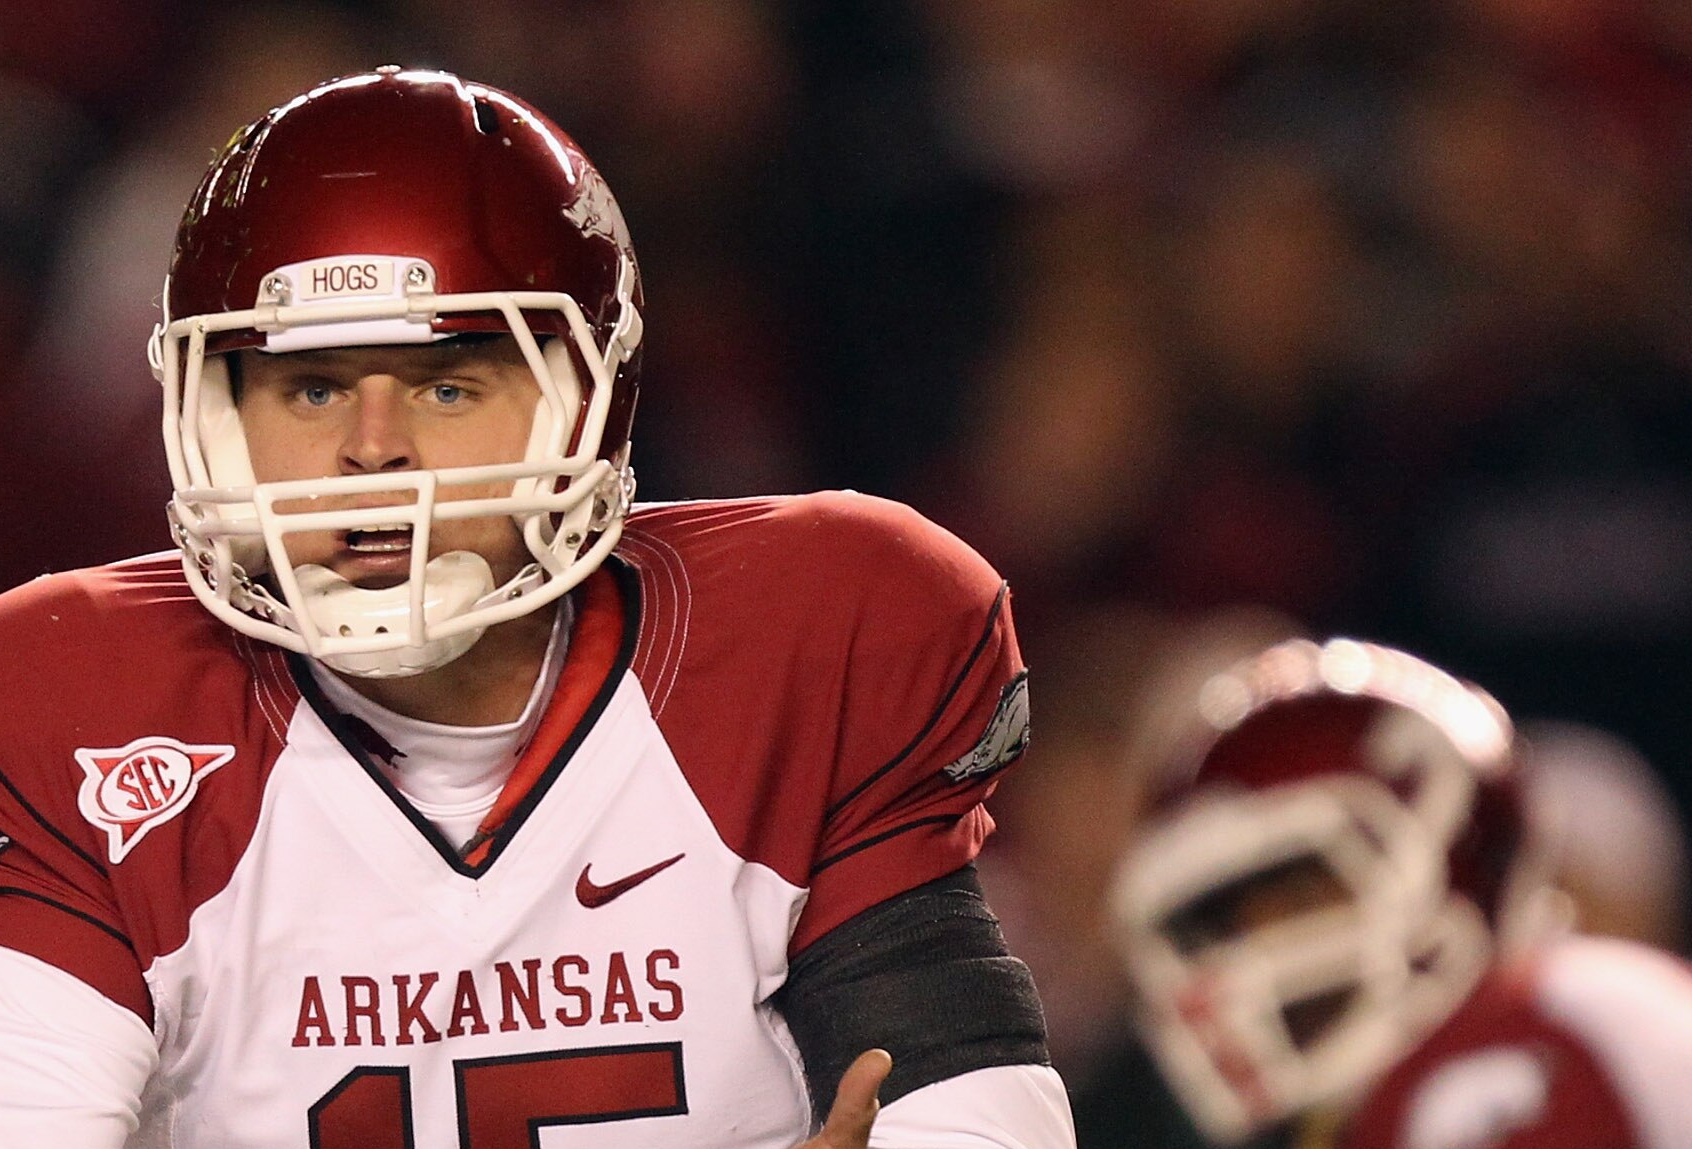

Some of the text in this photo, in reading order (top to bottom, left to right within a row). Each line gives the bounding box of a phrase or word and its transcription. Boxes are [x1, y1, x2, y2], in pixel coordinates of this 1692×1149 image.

[313, 263, 378, 293] HOGS
[116, 755, 175, 811] SEC
[291, 948, 684, 1047] ARKANSAS
